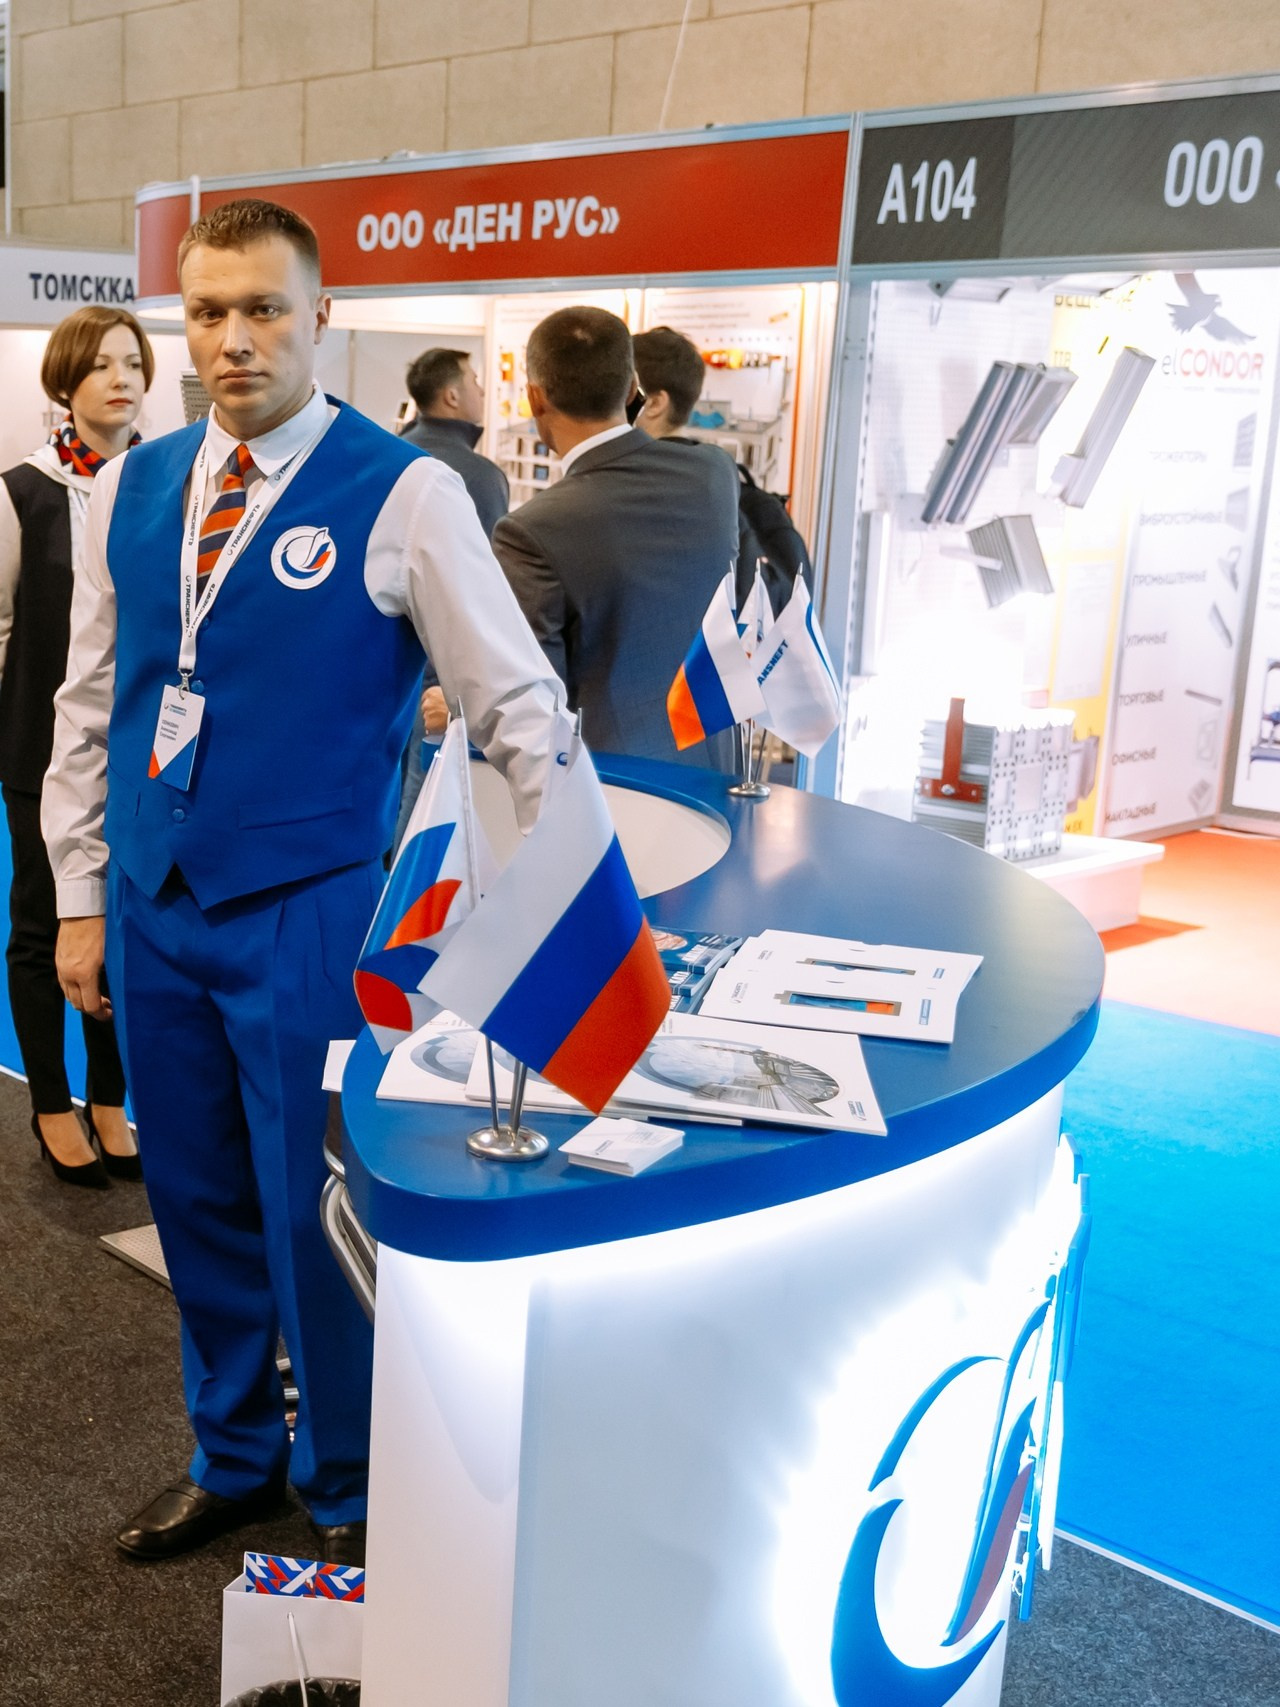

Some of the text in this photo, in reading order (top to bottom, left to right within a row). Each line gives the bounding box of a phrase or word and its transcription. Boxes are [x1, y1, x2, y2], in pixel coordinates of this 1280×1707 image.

[877, 156, 977, 224] A104
[357, 196, 619, 252] ООО «ДЕН РУС»
[29, 272, 135, 303] ТОМСККА
